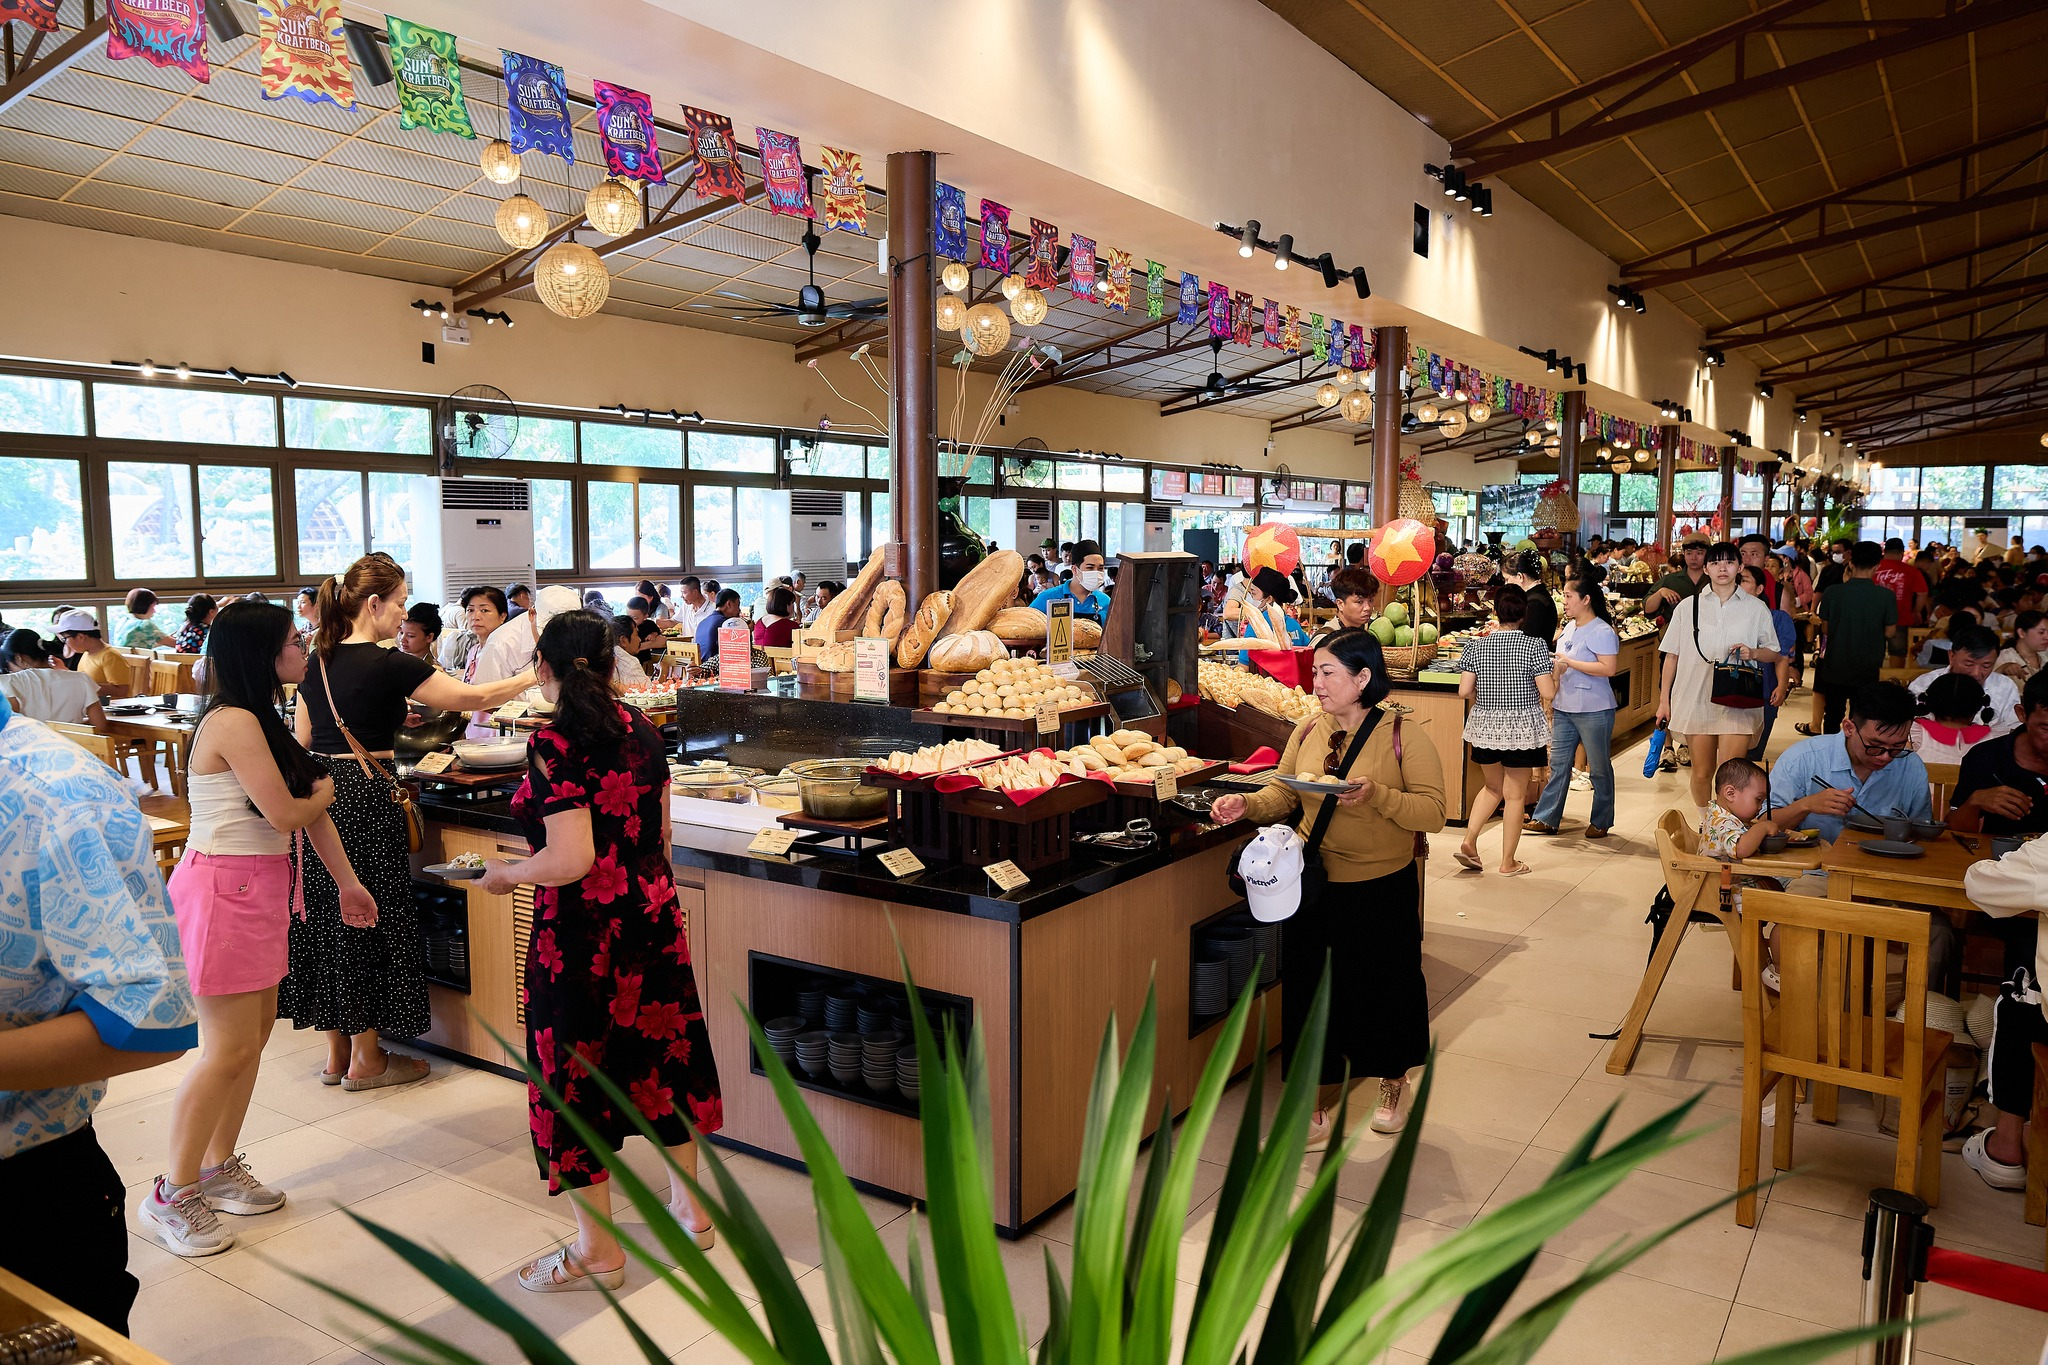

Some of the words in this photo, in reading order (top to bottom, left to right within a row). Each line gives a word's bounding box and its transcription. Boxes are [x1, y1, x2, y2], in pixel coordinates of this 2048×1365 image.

[280, 17, 307, 36] SUN
[277, 30, 332, 55] KRAFTBEER
[404, 57, 429, 74] SUN
[518, 83, 539, 99] SUN
[517, 94, 562, 112] KRAFTBEER
[610, 114, 631, 129] SUN
[697, 137, 716, 149] SUN
[768, 158, 784, 170] SUN
[832, 175, 846, 187] SUN
[1875, 569, 1905, 583] Tokyo
